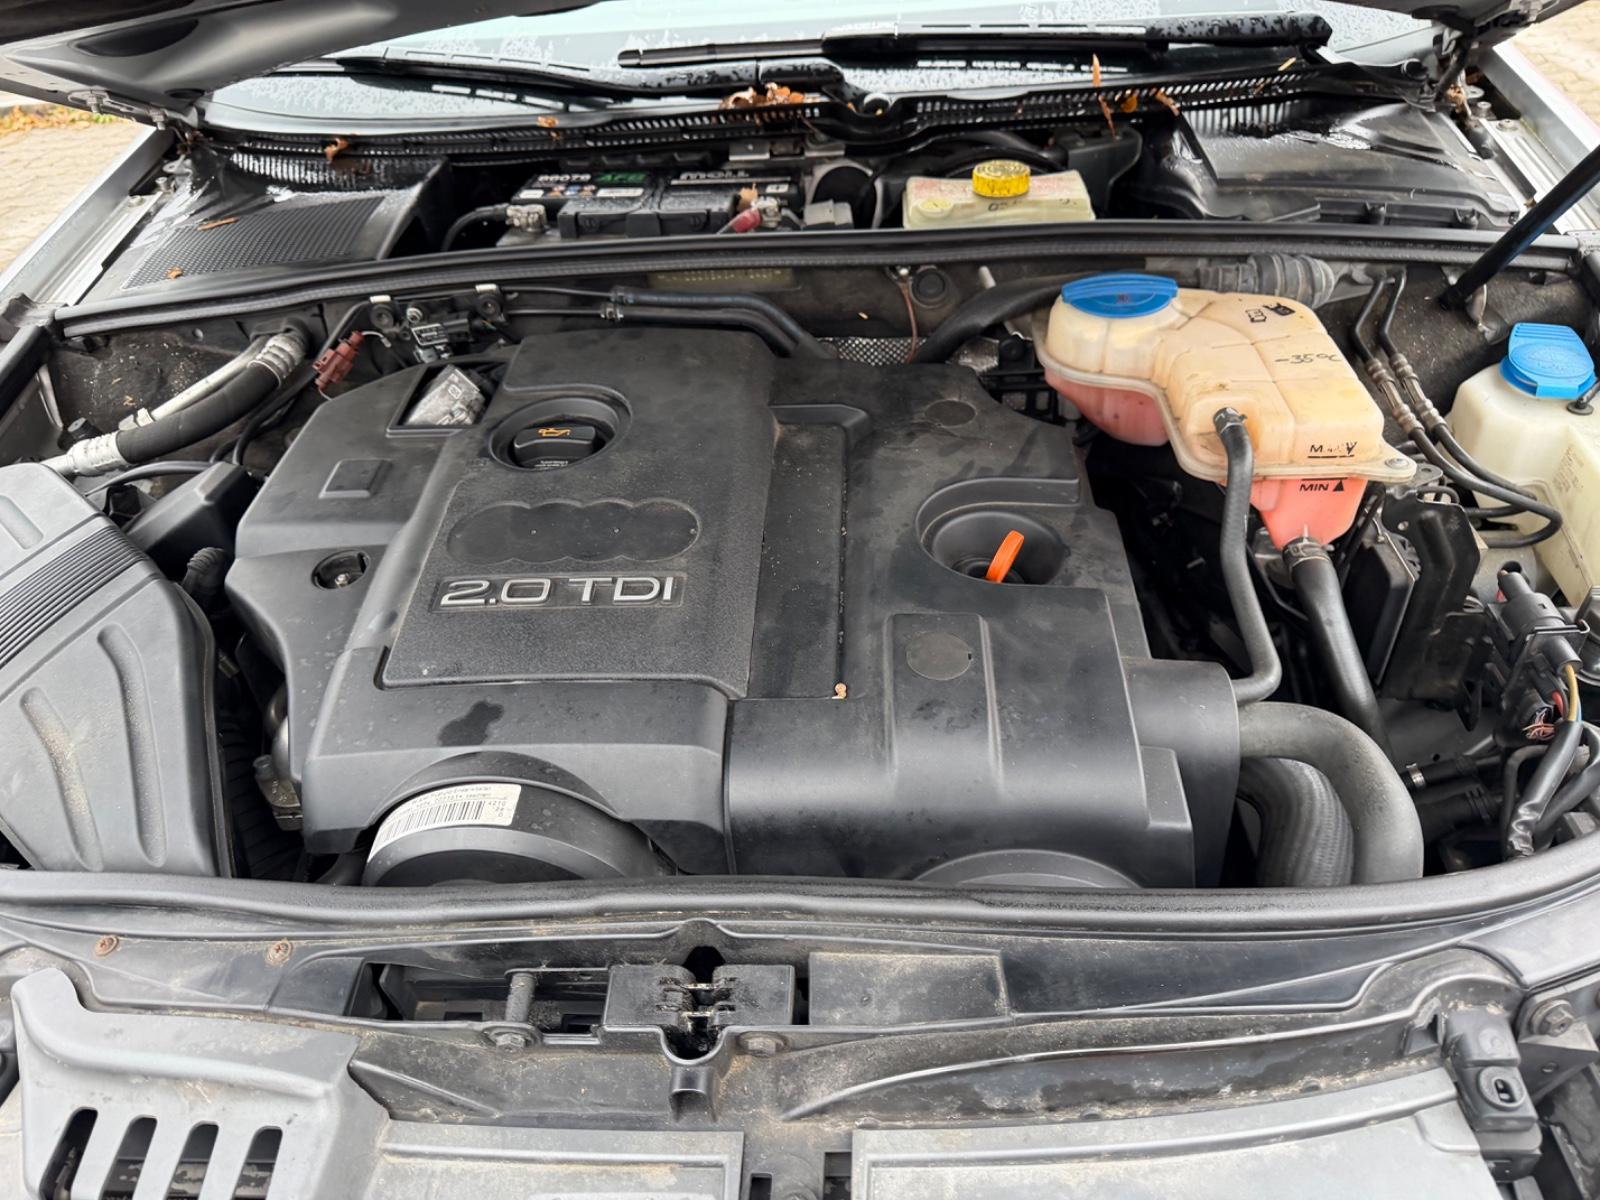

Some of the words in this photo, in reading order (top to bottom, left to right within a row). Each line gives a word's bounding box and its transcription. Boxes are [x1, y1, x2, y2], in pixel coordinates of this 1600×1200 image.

[1299, 483, 1330, 492] MIN
[440, 578, 550, 607] 2.0
[568, 576, 674, 604] TDI
